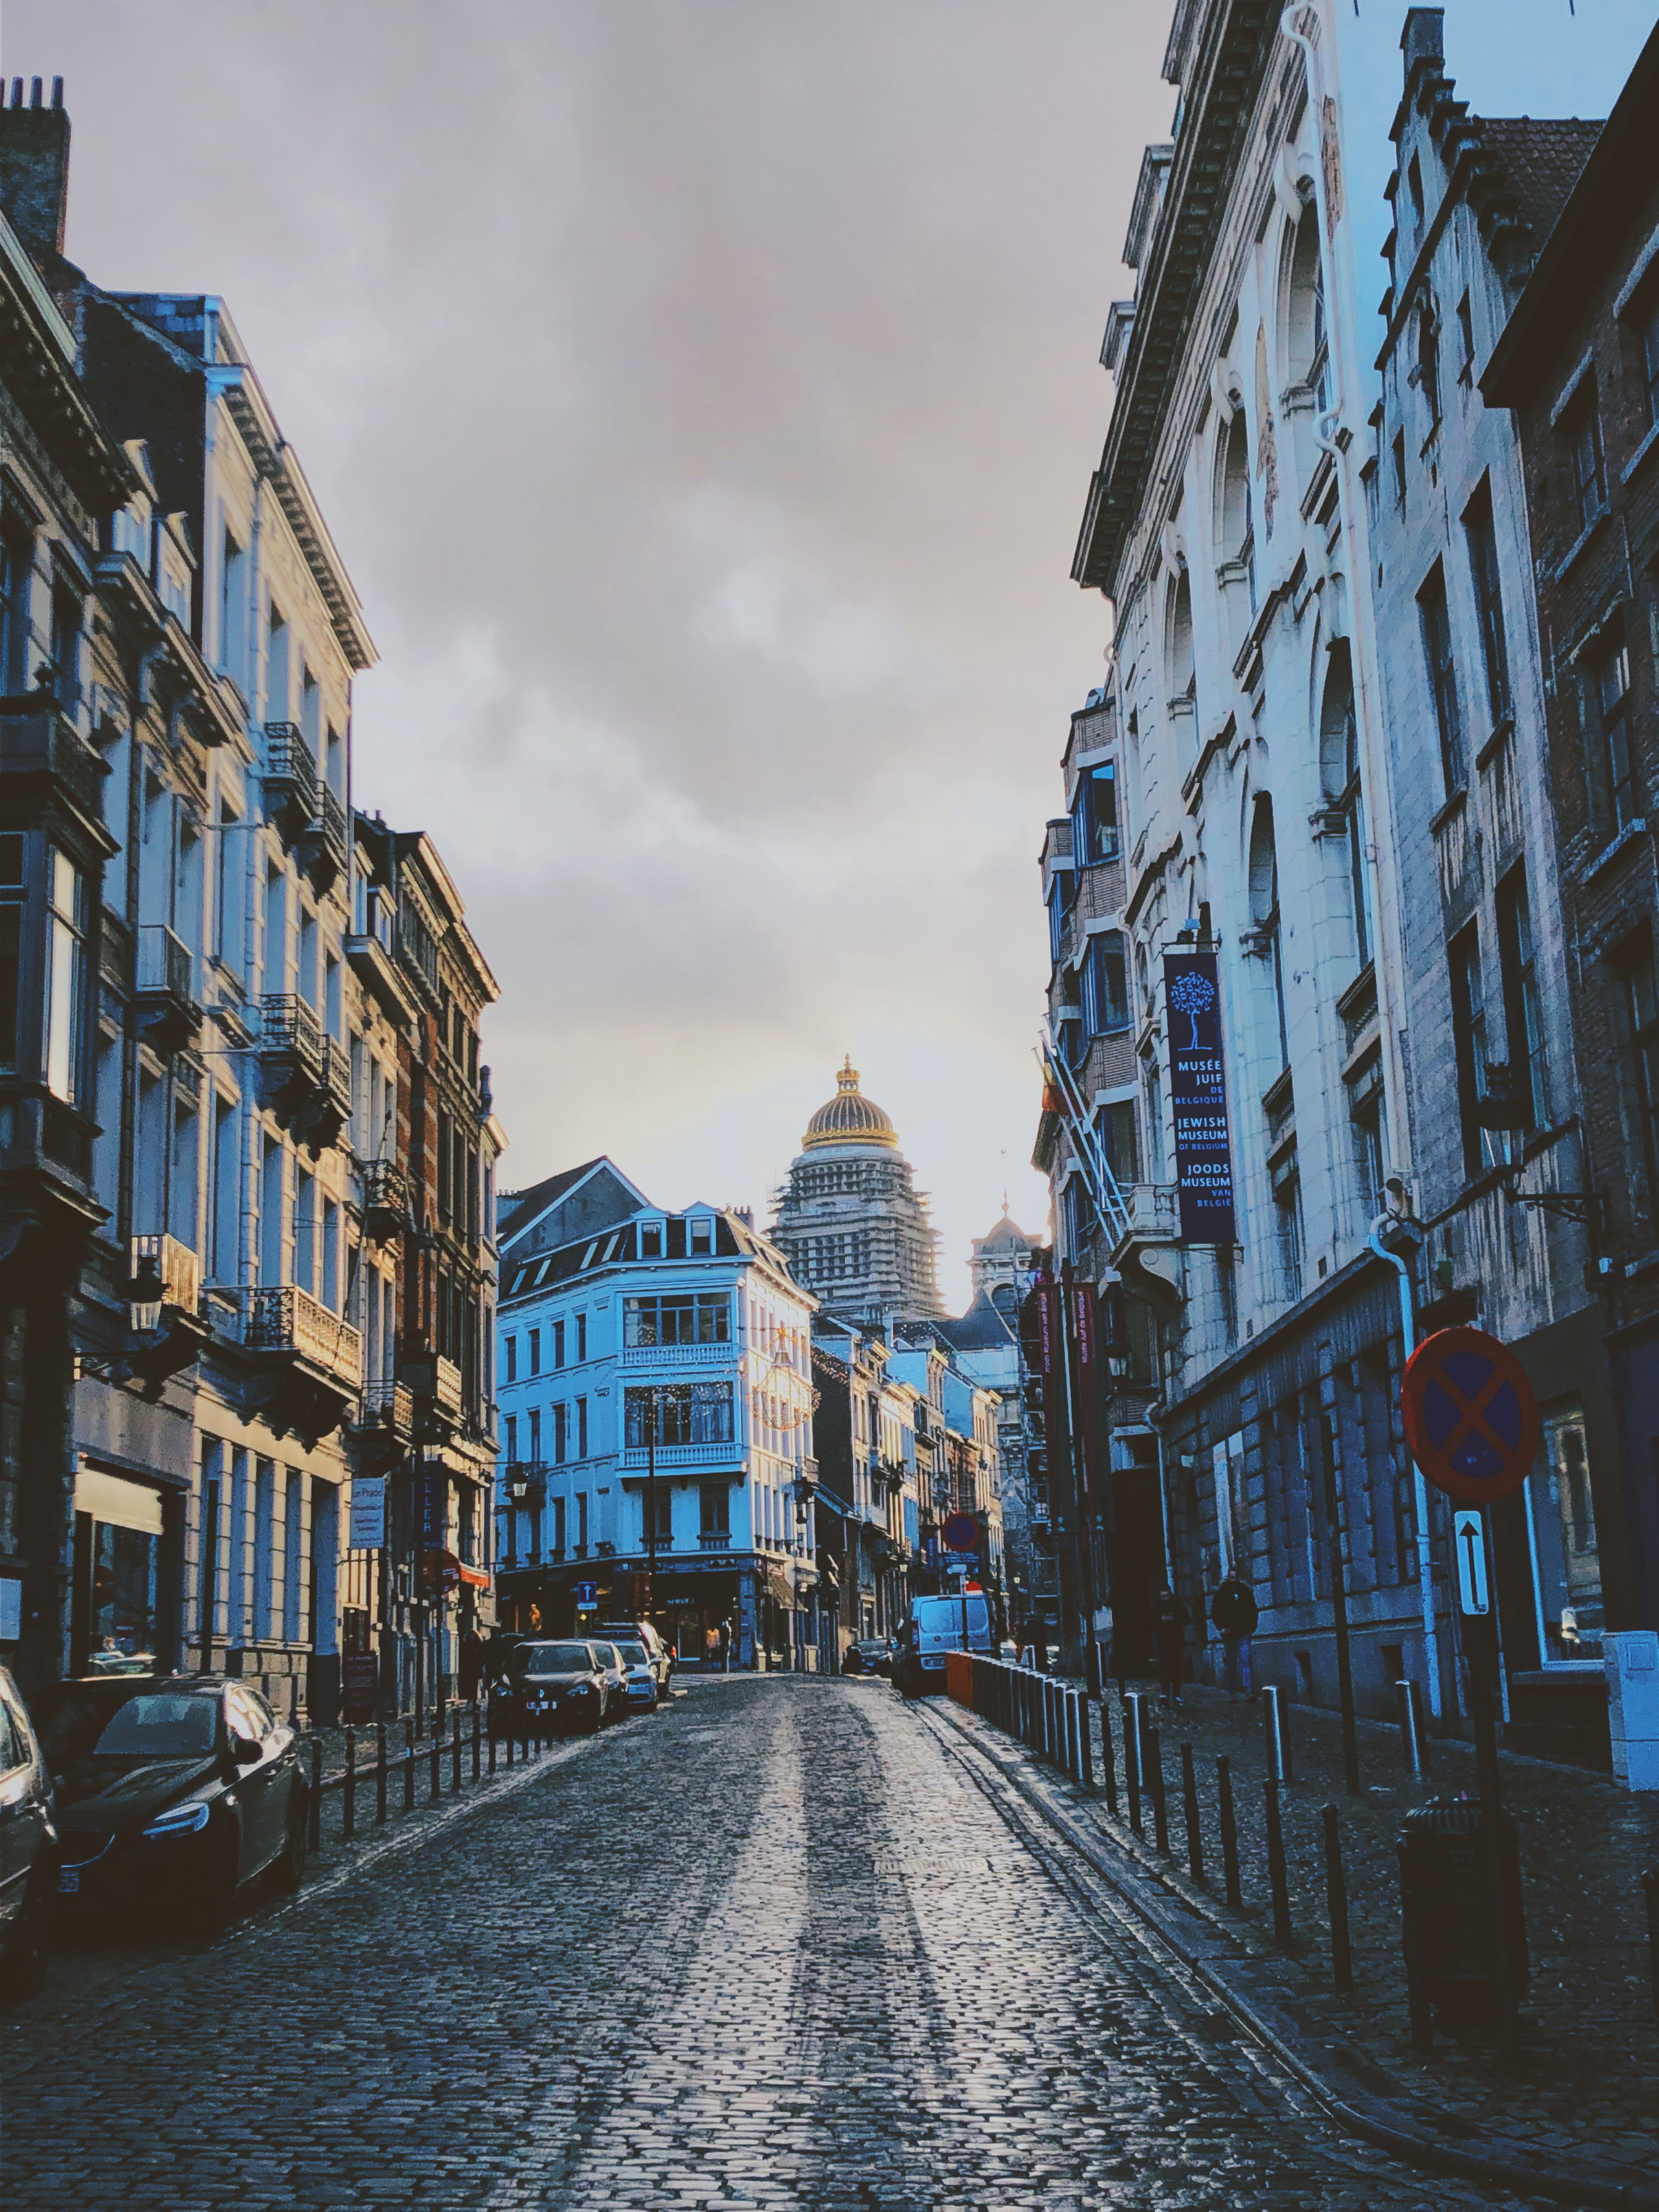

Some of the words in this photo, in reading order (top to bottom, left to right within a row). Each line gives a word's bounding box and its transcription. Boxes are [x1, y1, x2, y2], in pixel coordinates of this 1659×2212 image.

[1178, 1058, 1221, 1071] MUSÉE
[1196, 1074, 1222, 1086] JUIF
[1175, 1096, 1224, 1104] BELGIQUE
[1178, 1116, 1226, 1130] JEWISH
[1178, 1130, 1227, 1140] MUSEUM
[1188, 1164, 1229, 1176] JOODS
[1181, 1177, 1231, 1187] MUSEUM
